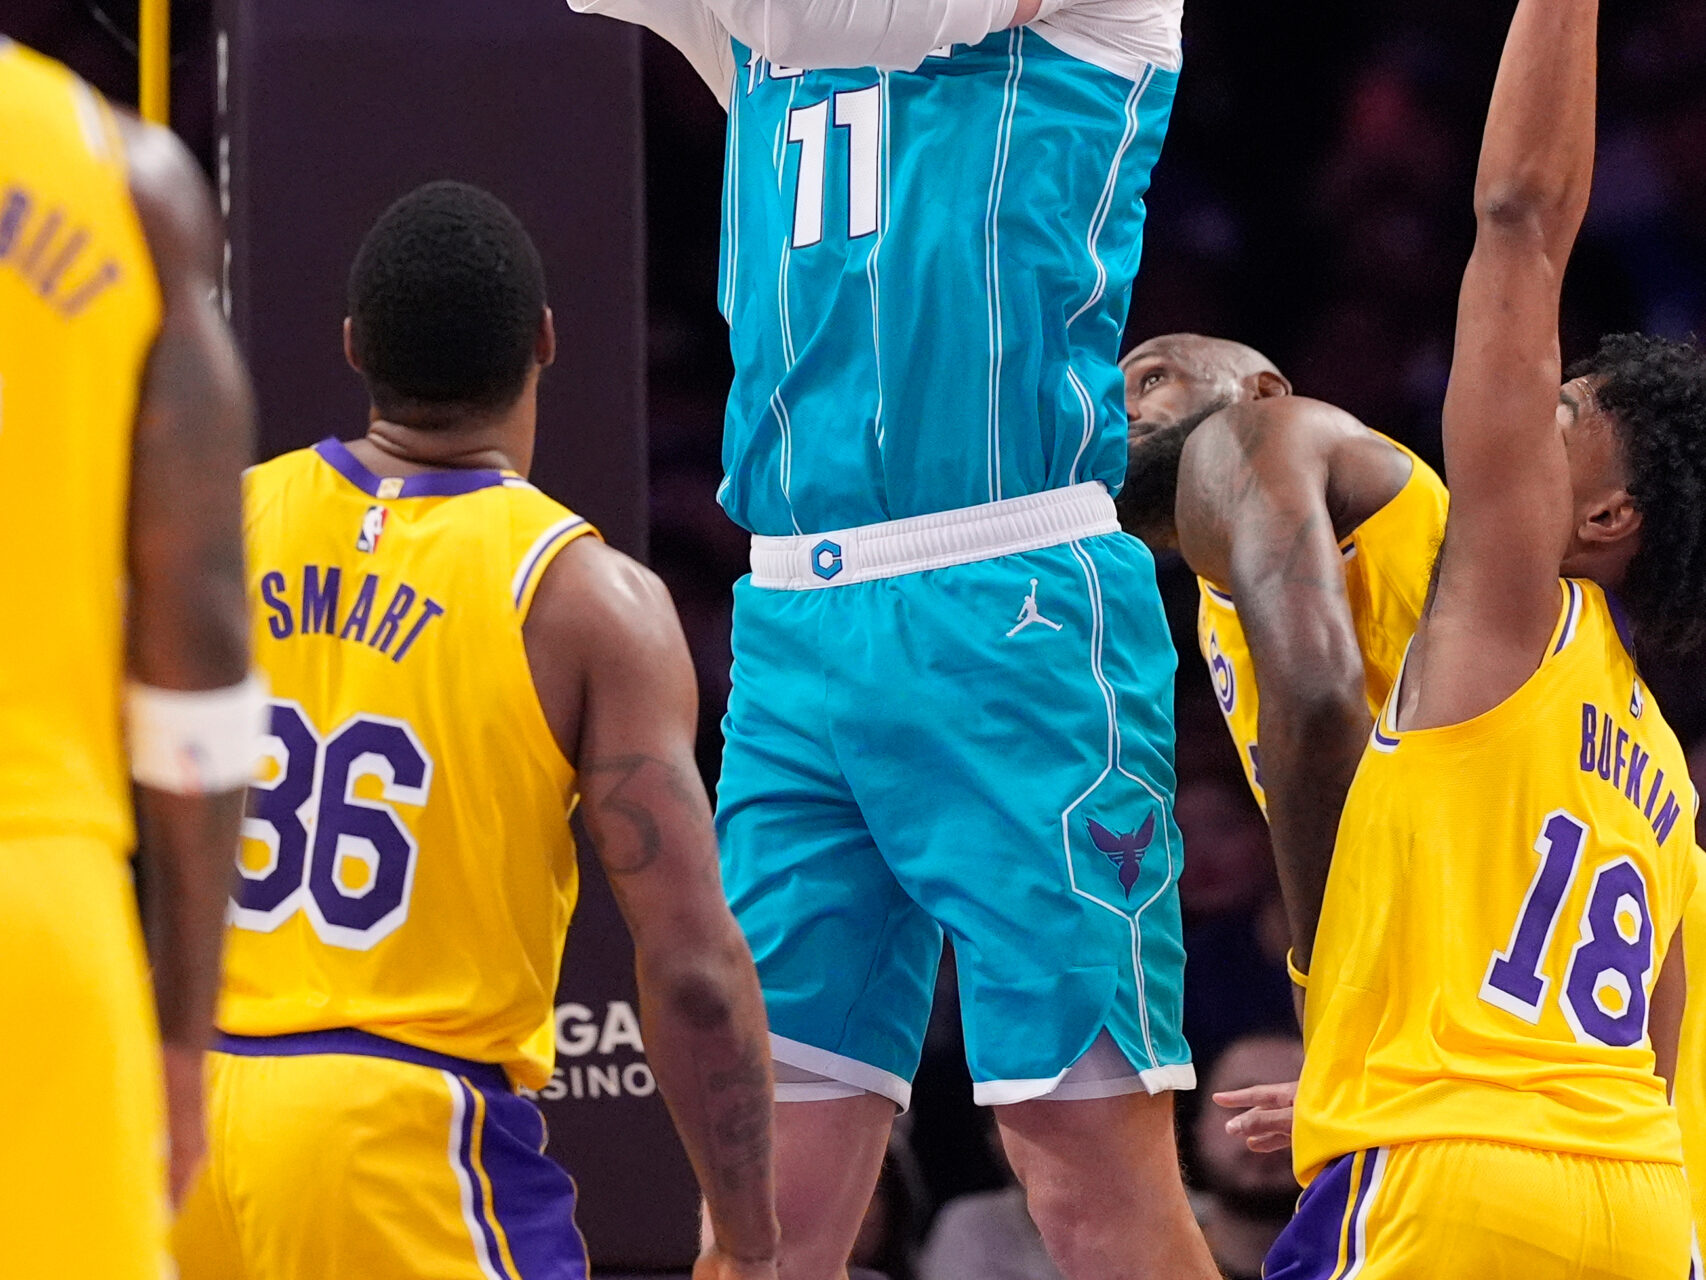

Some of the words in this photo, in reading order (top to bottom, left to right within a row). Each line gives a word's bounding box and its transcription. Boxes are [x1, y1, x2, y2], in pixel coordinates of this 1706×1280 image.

[787, 82, 880, 250] 11
[261, 565, 443, 662] SMART
[1580, 702, 1681, 848] BUFKIN
[1478, 808, 1655, 1047] 18
